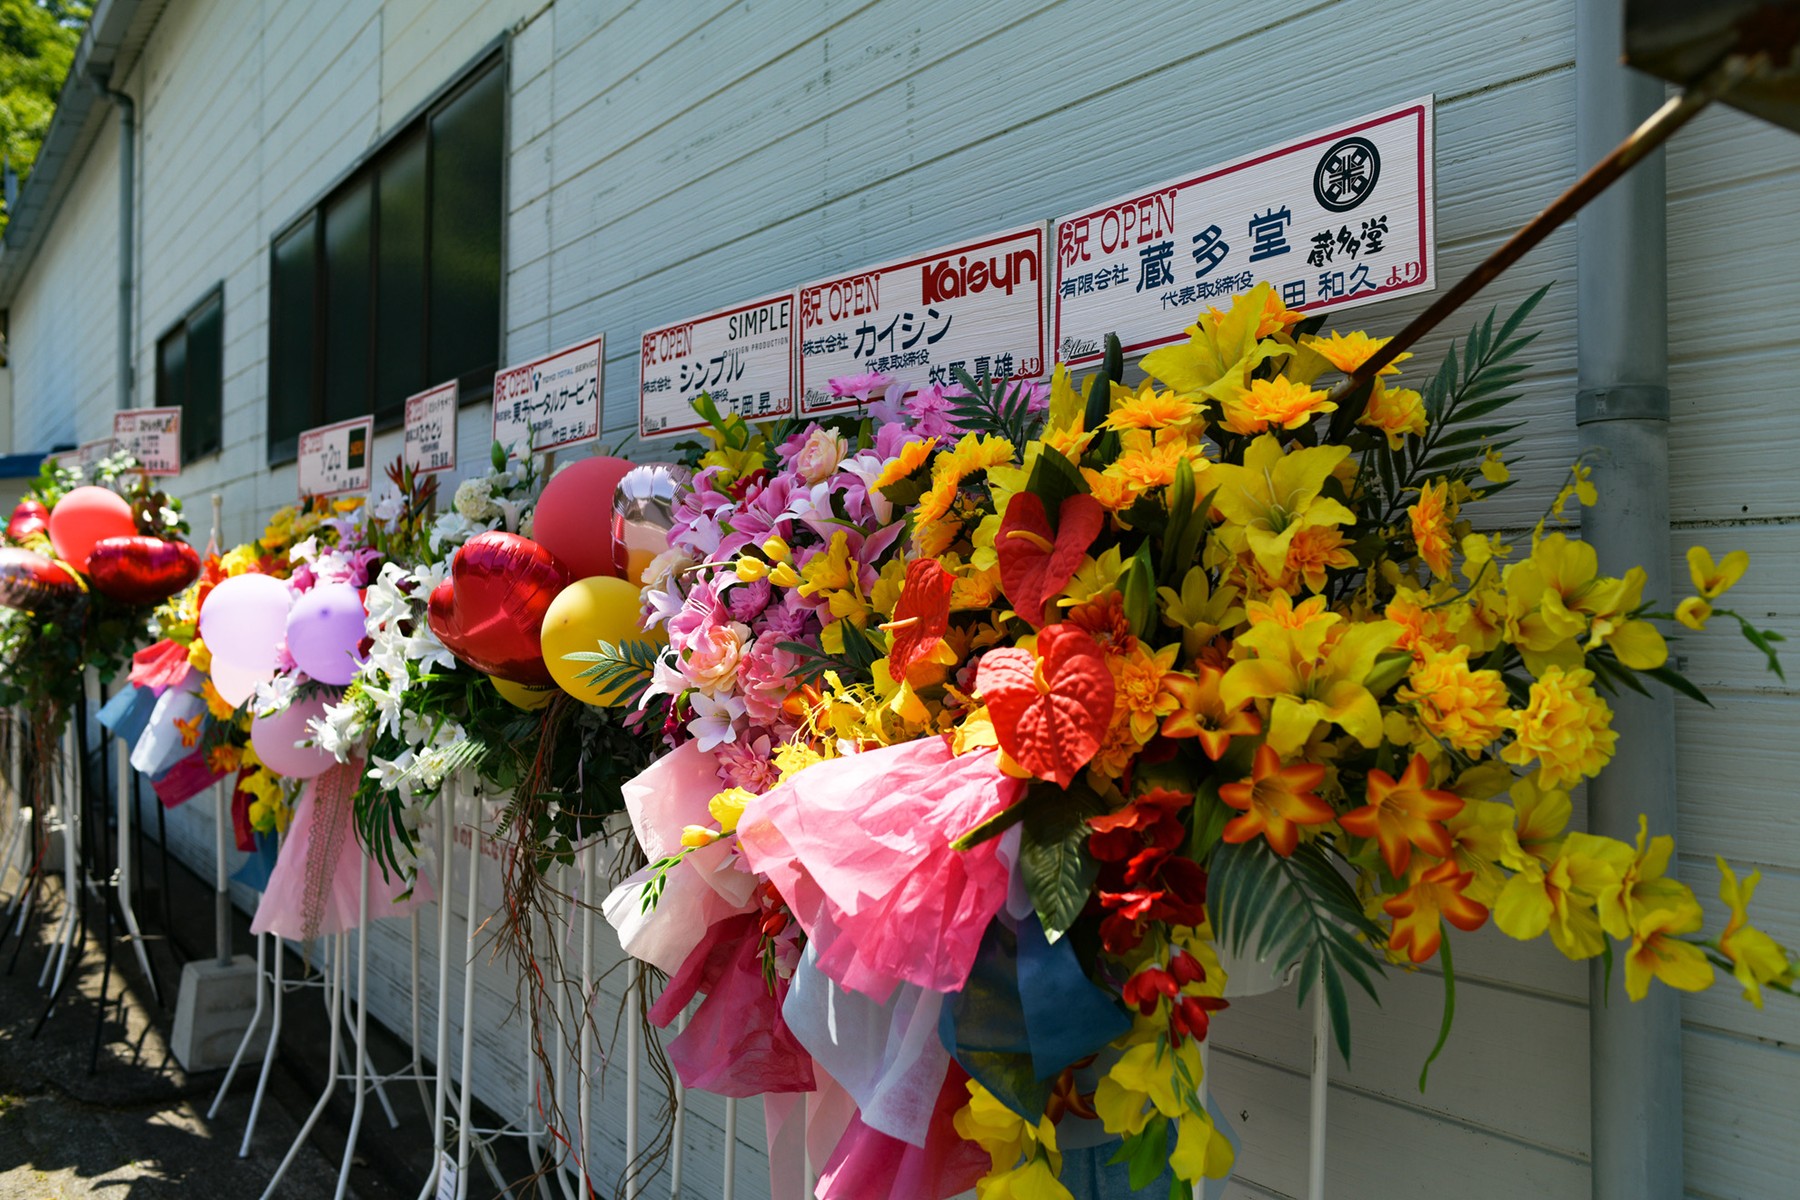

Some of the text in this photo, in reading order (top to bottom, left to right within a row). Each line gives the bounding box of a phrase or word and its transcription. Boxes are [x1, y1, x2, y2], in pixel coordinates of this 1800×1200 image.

[1061, 188, 1178, 268] 祝 OPEN
[1306, 215, 1389, 267] 蔵多堂
[1059, 204, 1291, 299] 有限会社 蔵多堂
[801, 273, 881, 329] 祝 OPEN
[1160, 270, 1254, 310] 代表取締役
[1317, 263, 1378, 302] 和久
[1385, 261, 1422, 288] より
[728, 302, 789, 341] SIMPLE
[751, 336, 789, 351] PRODUCTION
[802, 308, 953, 359] 株式会社 カイシン
[643, 324, 694, 368] 祝 OPEN
[865, 349, 931, 375] 代表取締役
[1017, 357, 1040, 375] より
[508, 367, 534, 398] OPEN
[680, 350, 745, 393] シンプル
